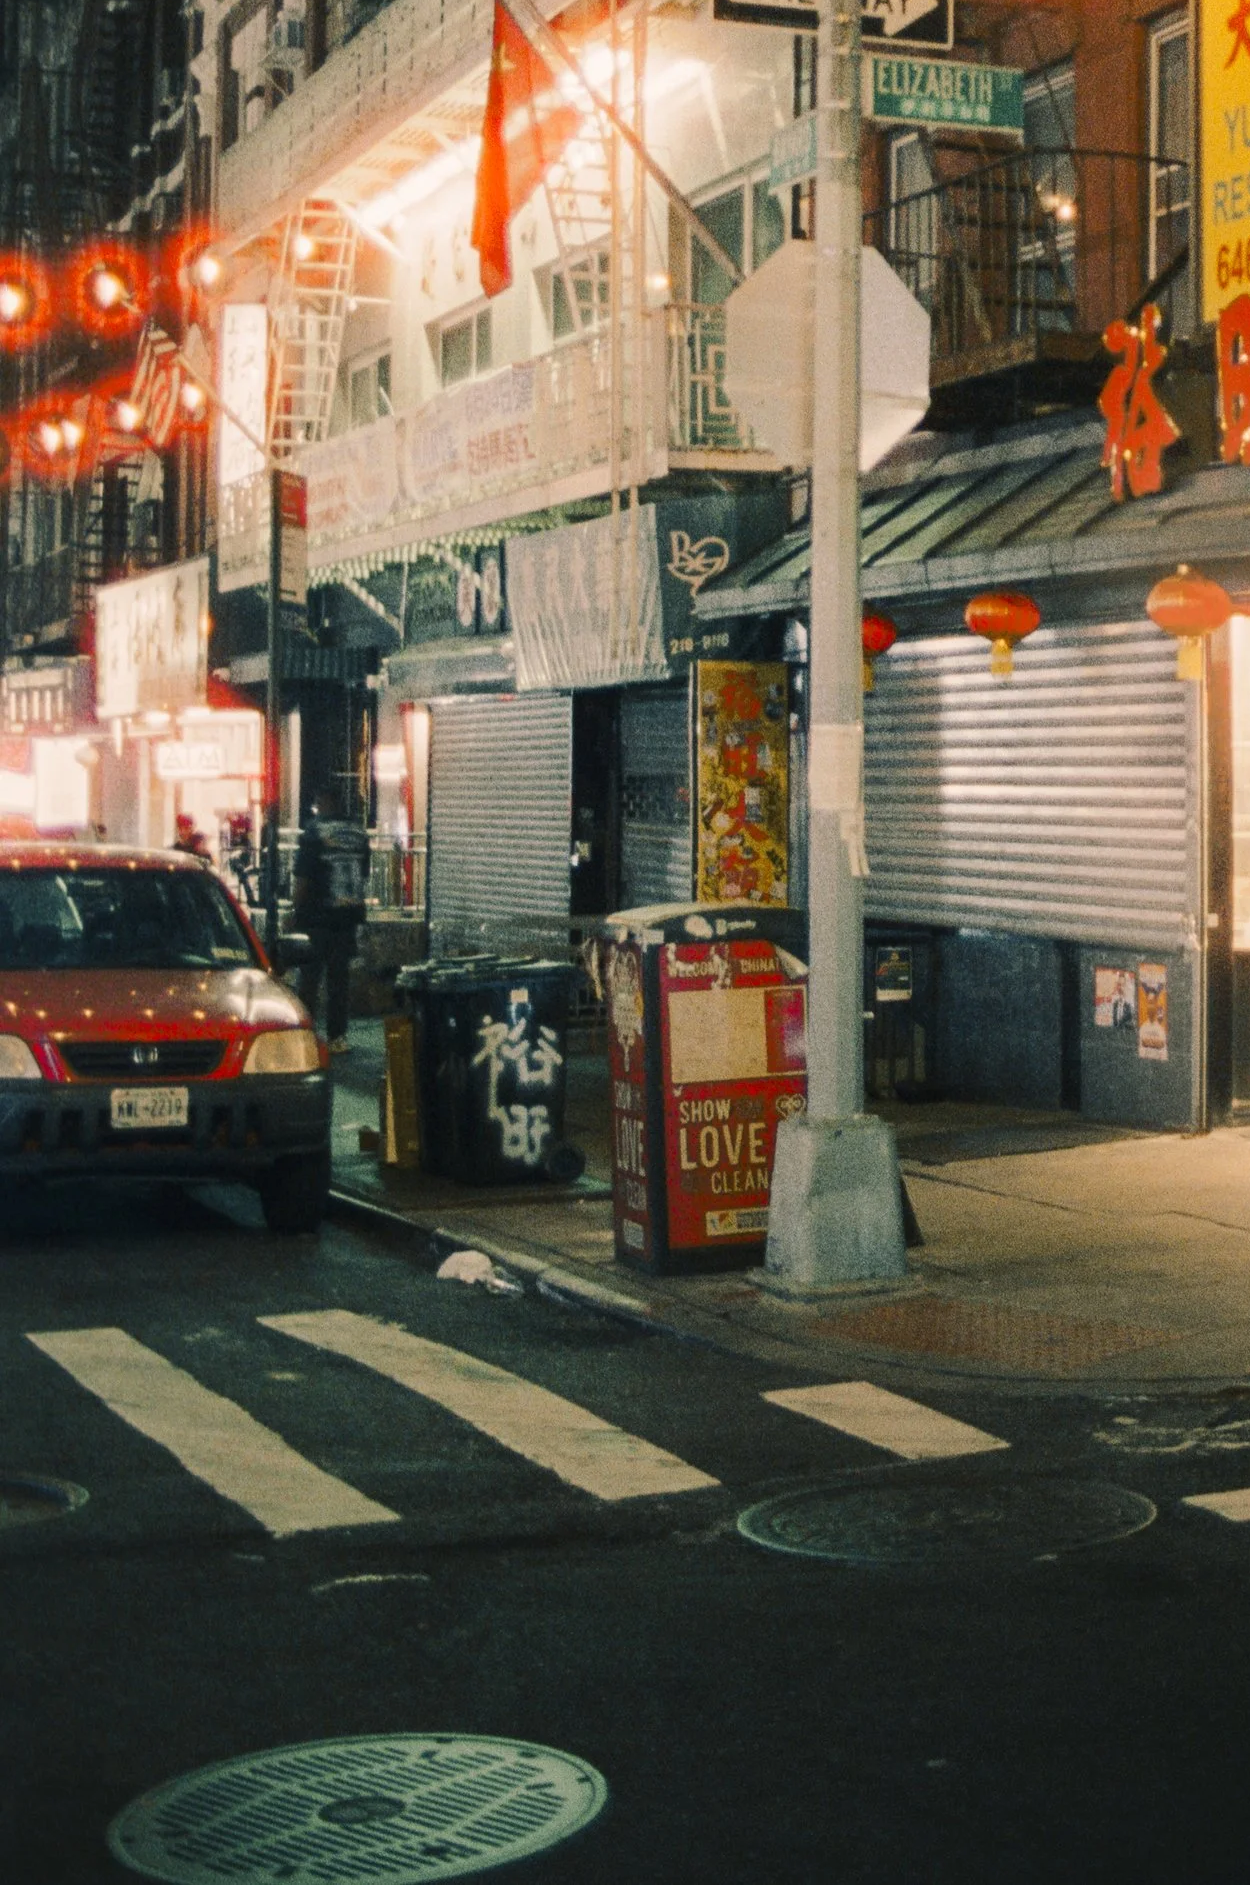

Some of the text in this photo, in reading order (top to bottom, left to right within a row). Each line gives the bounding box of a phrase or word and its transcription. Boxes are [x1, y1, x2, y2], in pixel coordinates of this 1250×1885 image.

[877, 61, 994, 103] ELIZABETH
[679, 1098, 732, 1124] SHOW
[679, 1121, 767, 1170] LOVE
[711, 1168, 770, 1194] CLEAN
